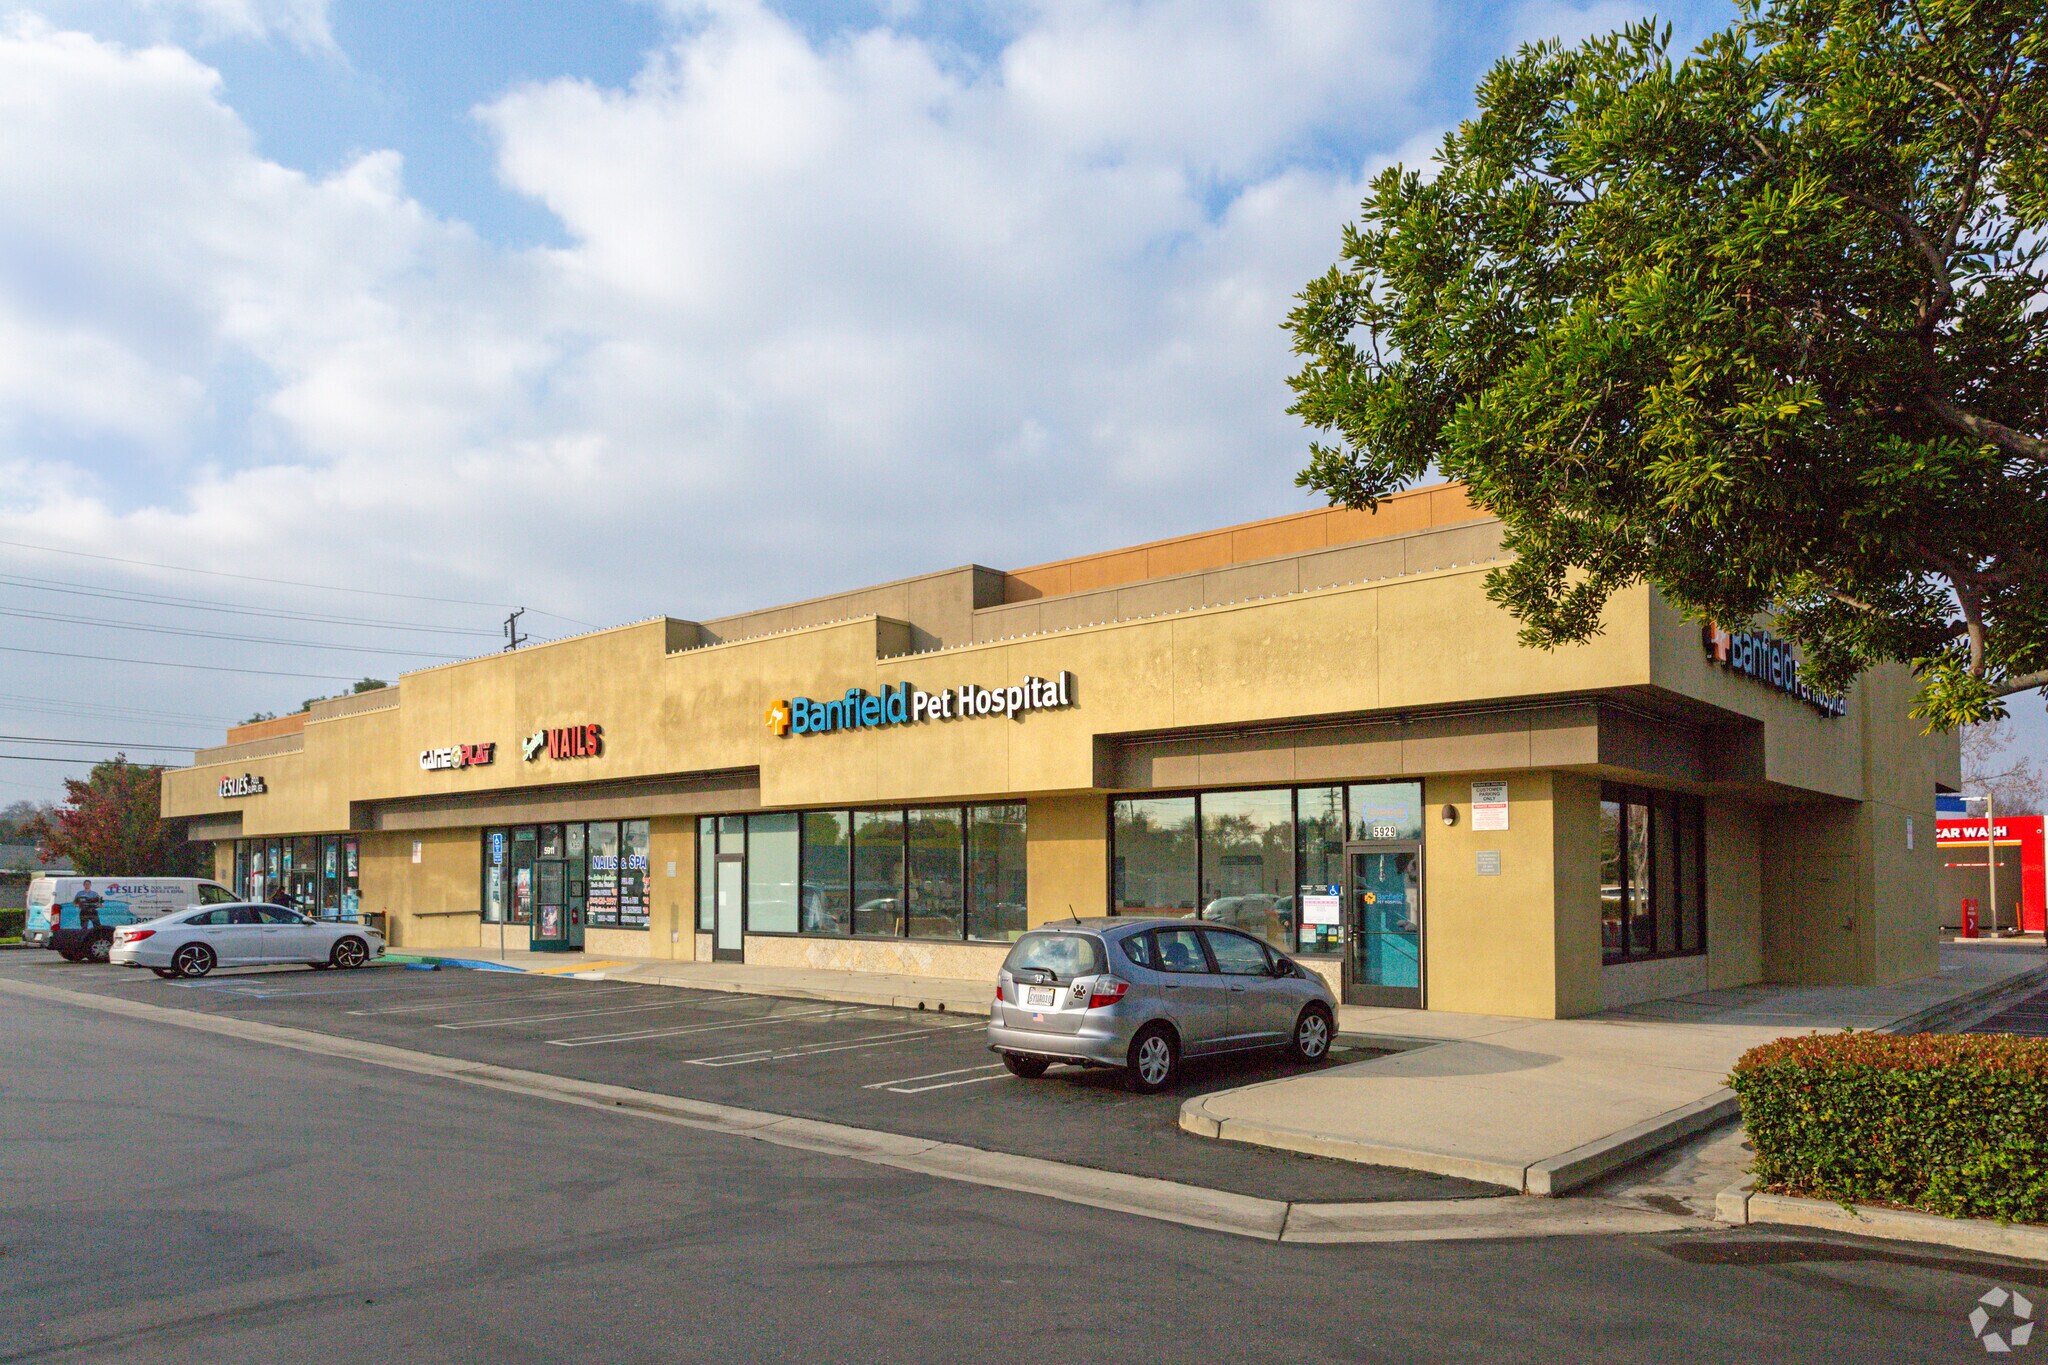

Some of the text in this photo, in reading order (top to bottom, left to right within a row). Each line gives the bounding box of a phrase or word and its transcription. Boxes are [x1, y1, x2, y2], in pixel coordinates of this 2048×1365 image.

[1732, 630, 1792, 691] Banfield
[791, 670, 1069, 733] Banfield Pet Hospital
[548, 723, 597, 759] NAILS
[419, 742, 491, 770] GAME PLAY
[218, 773, 248, 797] LESLIE'S
[1374, 827, 1396, 837] 5929
[592, 855, 647, 870] NAILS & SPA
[109, 884, 150, 894] LESLIE'S
